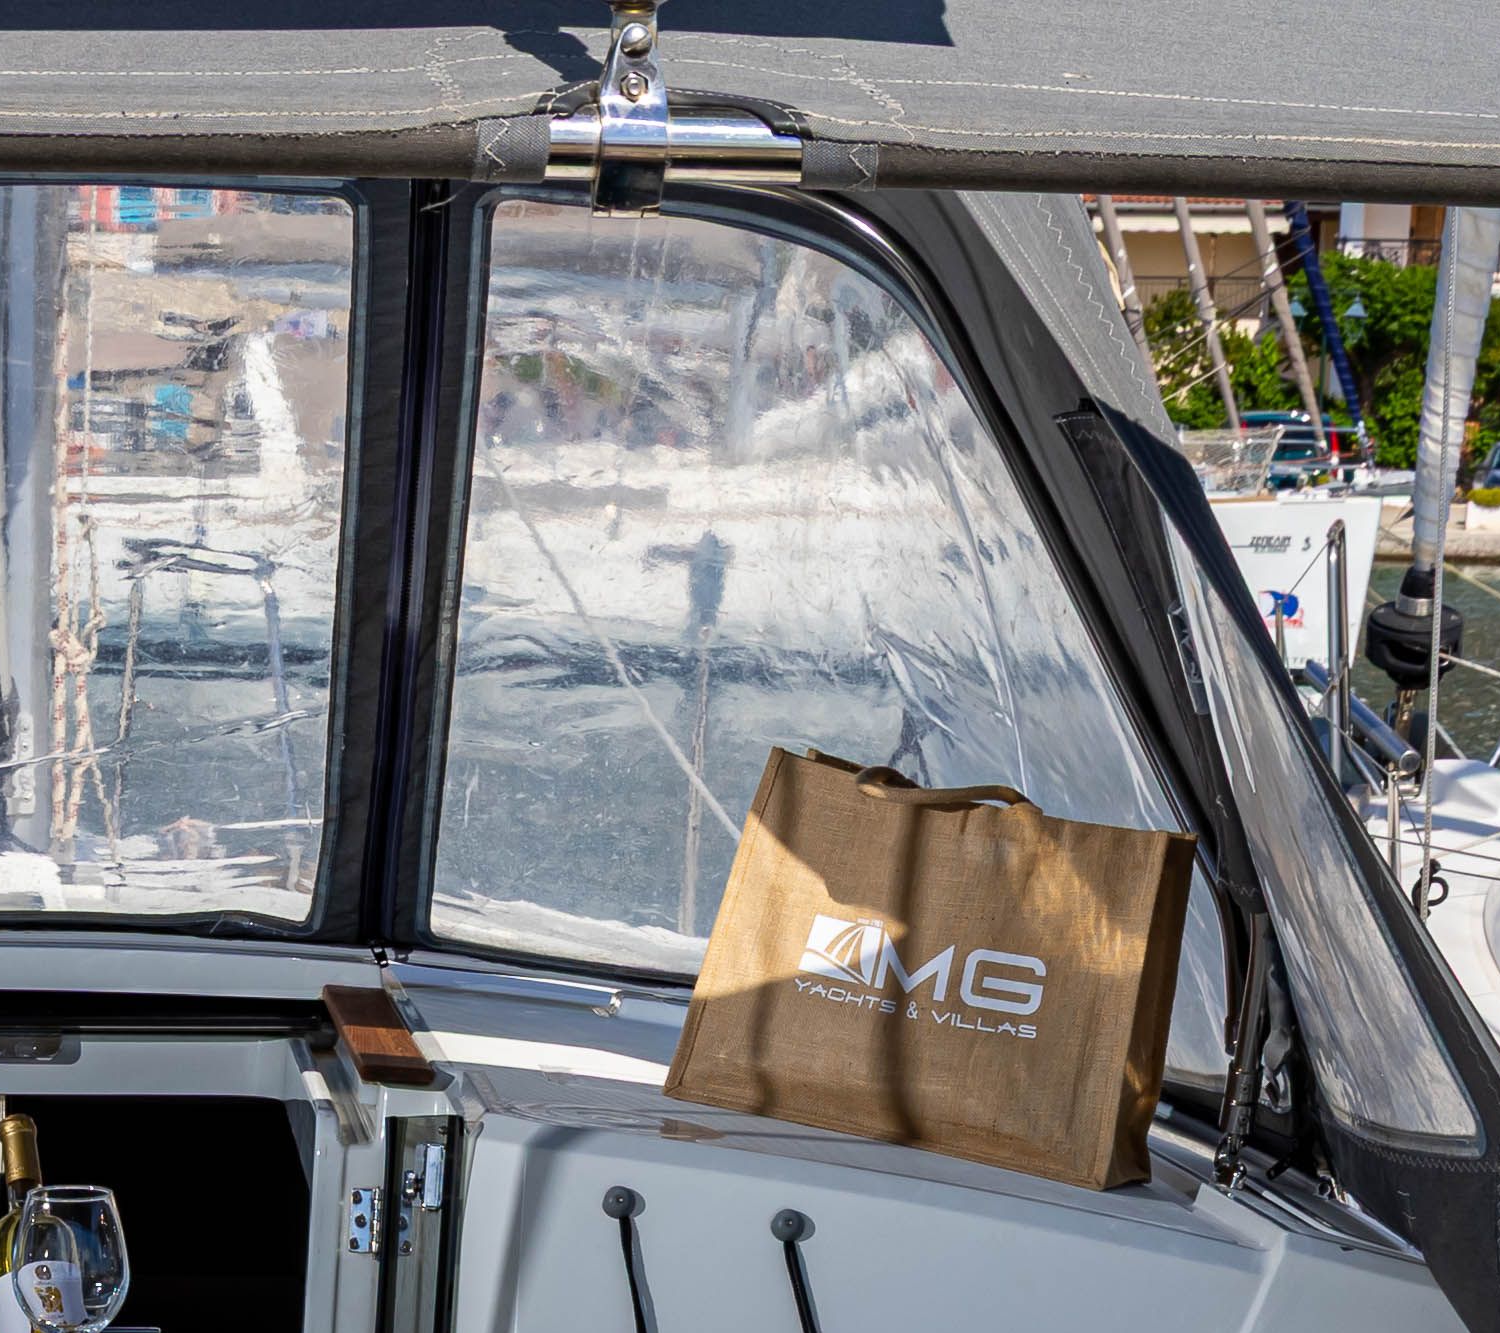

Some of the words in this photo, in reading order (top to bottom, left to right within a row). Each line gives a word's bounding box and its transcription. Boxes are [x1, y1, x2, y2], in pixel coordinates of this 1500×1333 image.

[794, 977, 897, 1014] YACHTS
[906, 1001, 919, 1019] &
[931, 1009, 1038, 1040] VILLAS
